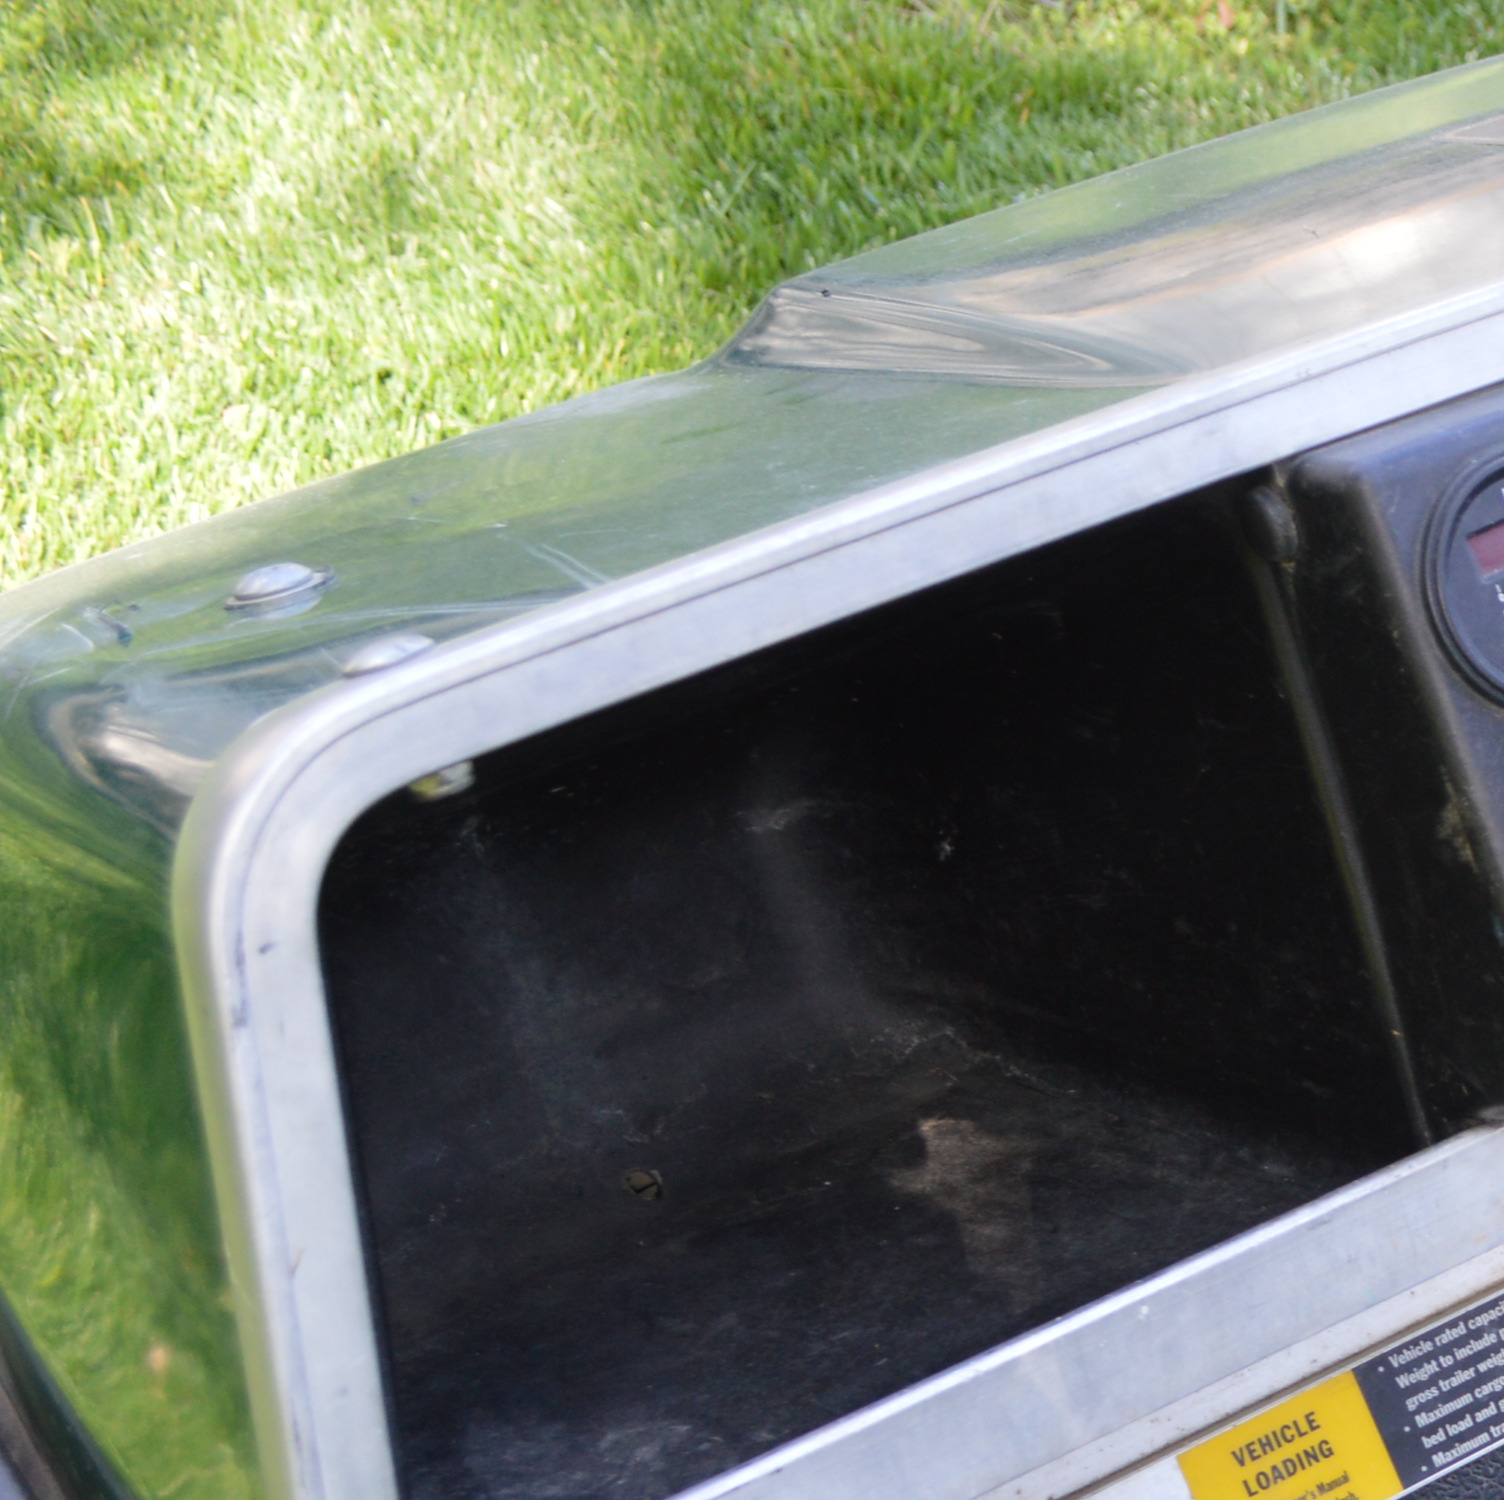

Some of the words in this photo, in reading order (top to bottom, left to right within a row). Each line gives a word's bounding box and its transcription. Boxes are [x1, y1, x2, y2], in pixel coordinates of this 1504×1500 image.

[1387, 1339, 1434, 1368] Vehicle
[1433, 1320, 1467, 1347] rated
[1394, 1358, 1440, 1389] Weight
[1437, 1354, 1454, 1368] to
[1452, 1331, 1498, 1361] include
[1404, 1385, 1440, 1412] gross
[1437, 1366, 1476, 1392] trailer
[1230, 1410, 1321, 1467] VEHICLE
[1420, 1426, 1447, 1449] bed
[1444, 1412, 1474, 1437] load
[1473, 1400, 1498, 1423] and
[1241, 1438, 1334, 1497] LOADING
[1430, 1431, 1491, 1468] Maximum
[1315, 1470, 1350, 1495] Manual
